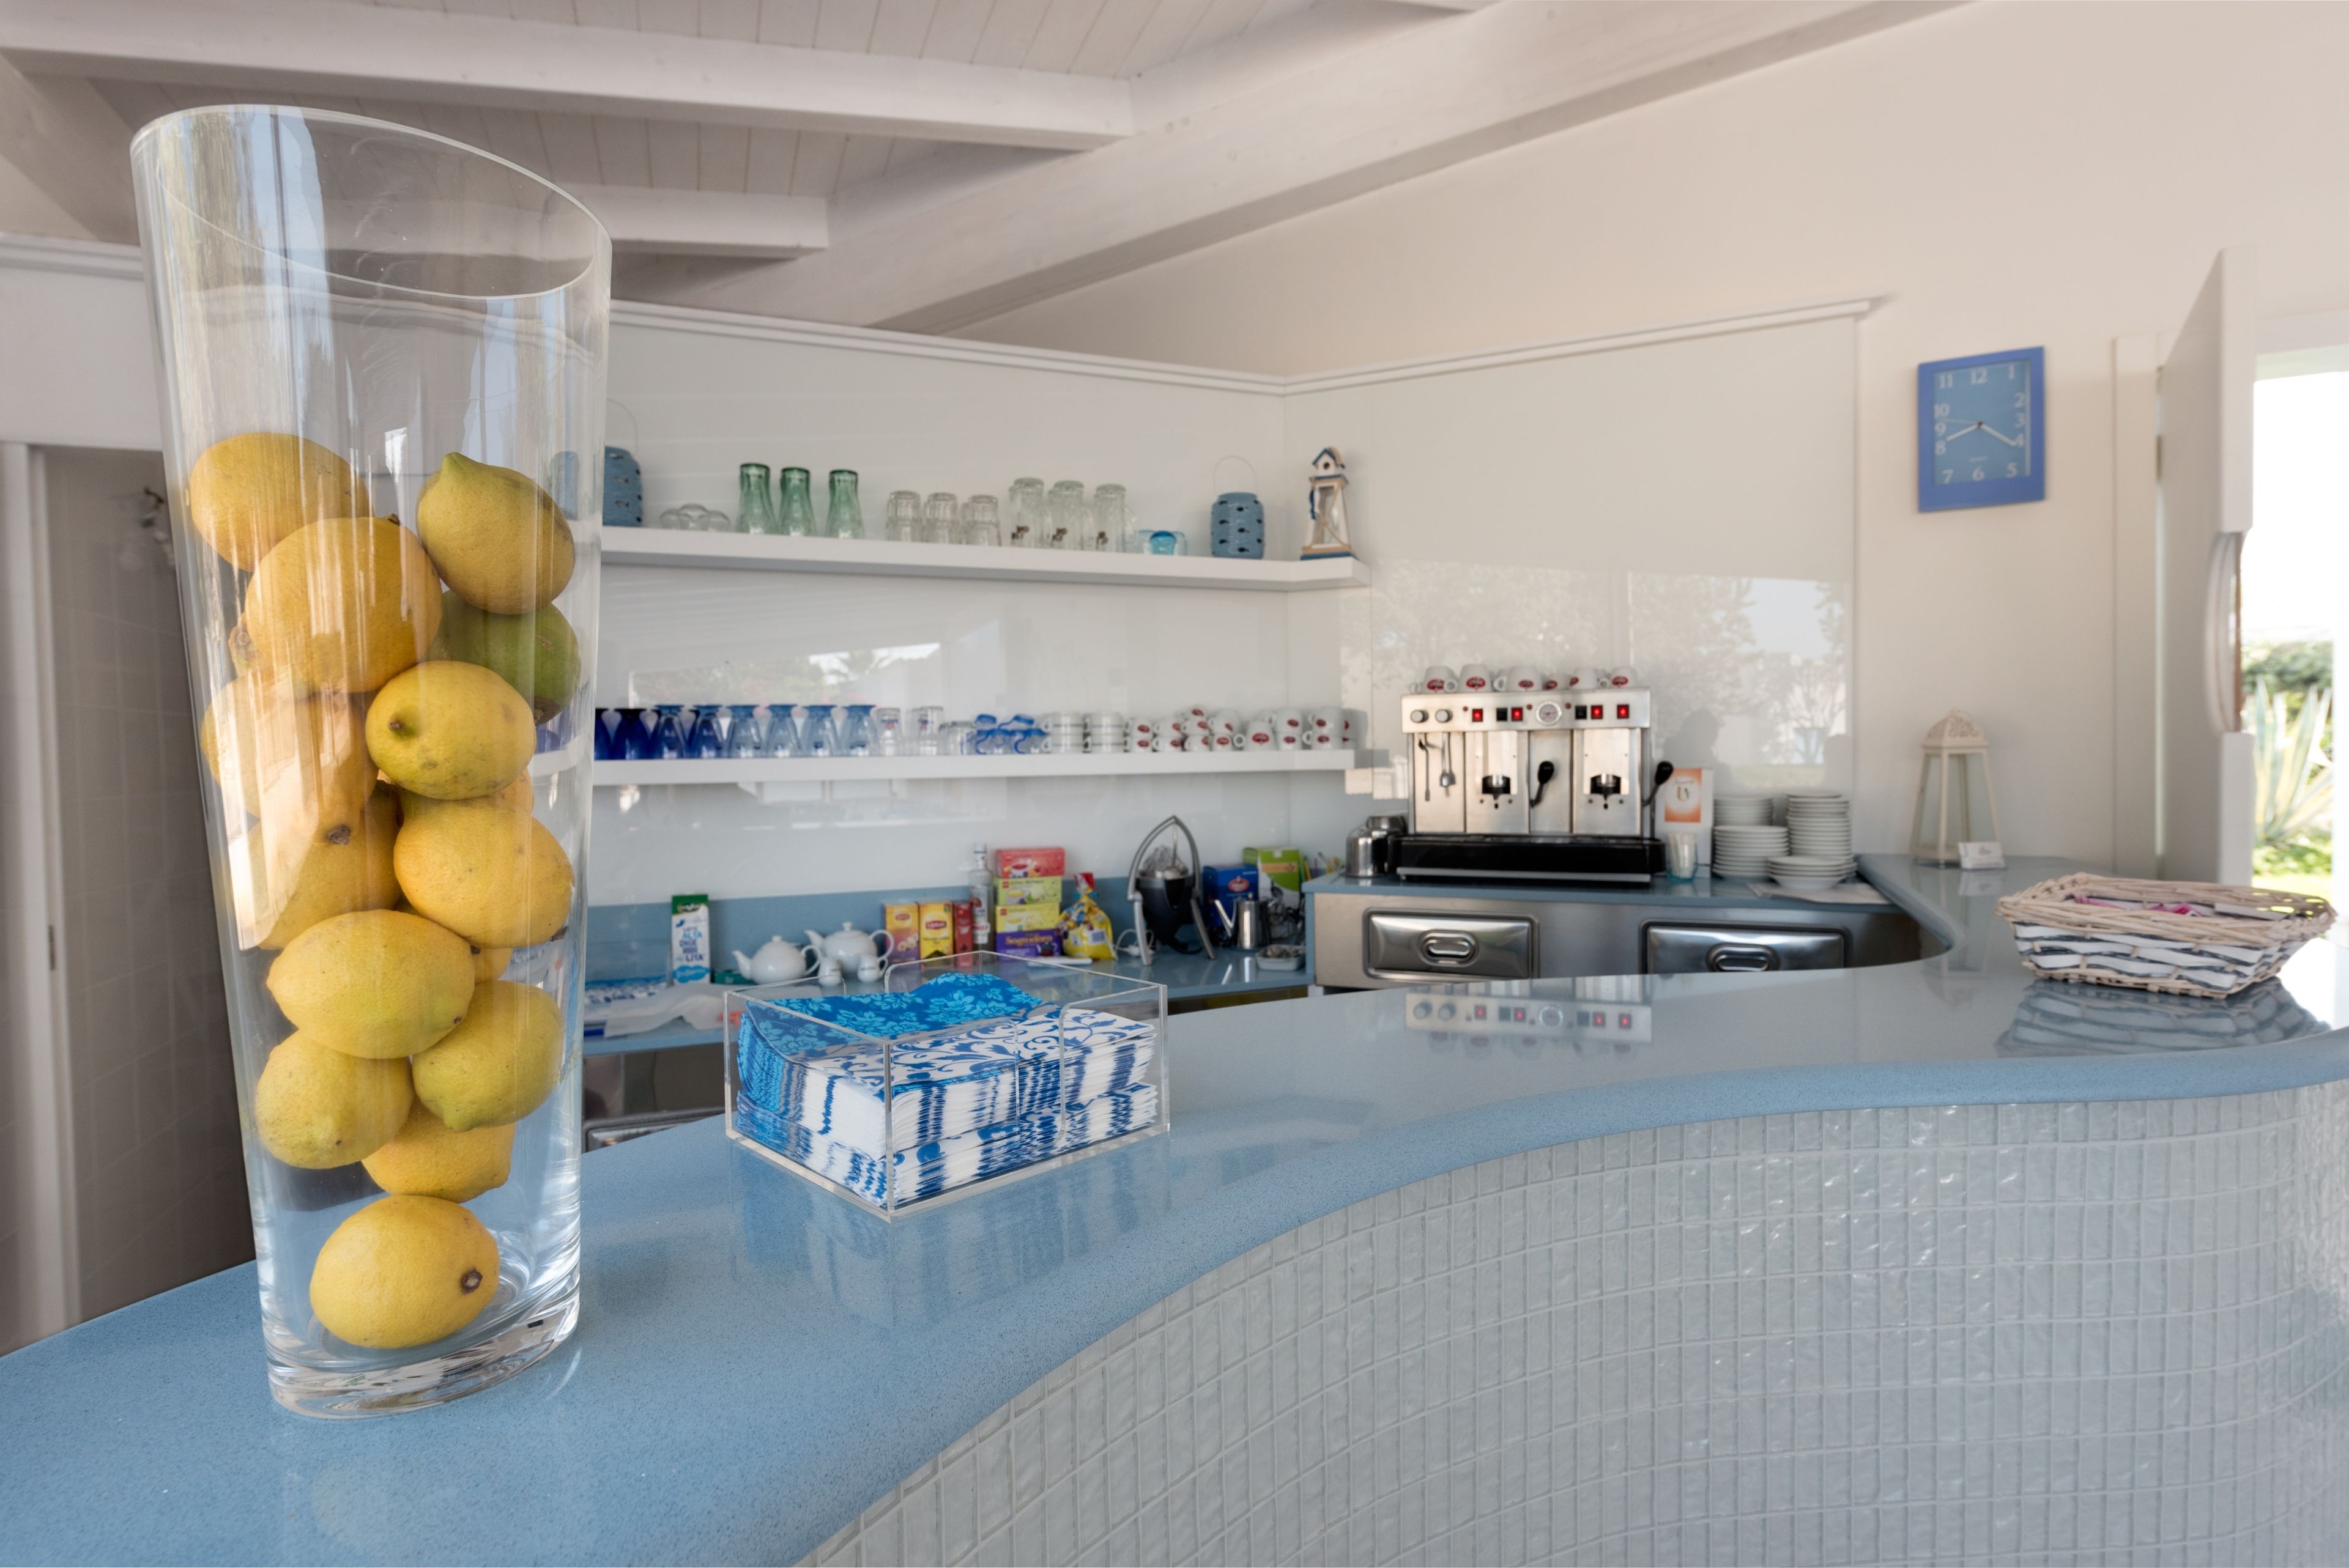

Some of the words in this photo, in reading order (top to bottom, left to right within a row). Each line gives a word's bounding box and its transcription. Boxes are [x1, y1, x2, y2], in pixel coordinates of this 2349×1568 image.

[1940, 372, 1953, 389] 11
[1970, 368, 1987, 385] 12
[2008, 365, 2015, 380] 1
[2015, 391, 2025, 409] 2
[1934, 402, 1950, 419] 10
[2016, 412, 2026, 428] 3
[1934, 422, 1946, 437] 9
[1935, 440, 1946, 456] 8
[1942, 468, 1954, 484] 7
[1972, 466, 1984, 482] 6
[2006, 462, 2017, 478] 5
